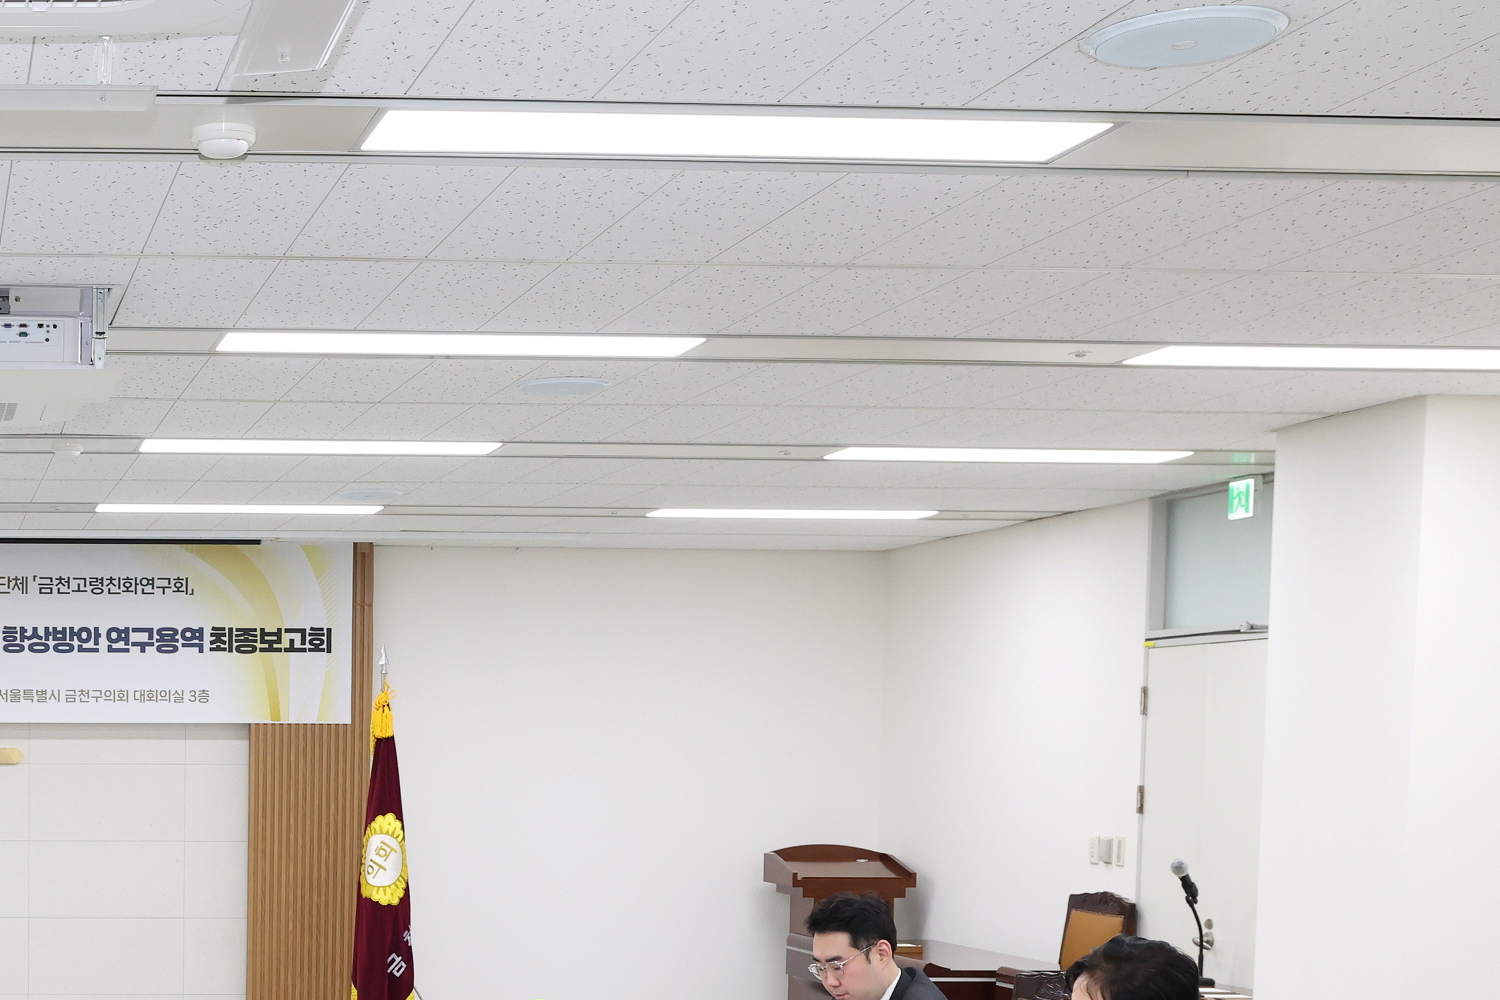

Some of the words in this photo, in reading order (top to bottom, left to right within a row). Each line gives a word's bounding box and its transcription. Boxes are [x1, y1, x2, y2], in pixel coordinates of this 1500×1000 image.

[32, 574, 195, 596] 「금천고령친화연구회」
[1, 625, 102, 654] 향상방안
[105, 626, 204, 654] 연구용역
[209, 626, 333, 655] 최종보고회
[65, 688, 129, 704] 금천구의회
[133, 688, 185, 704] 대회의실
[188, 689, 210, 704] 3층
